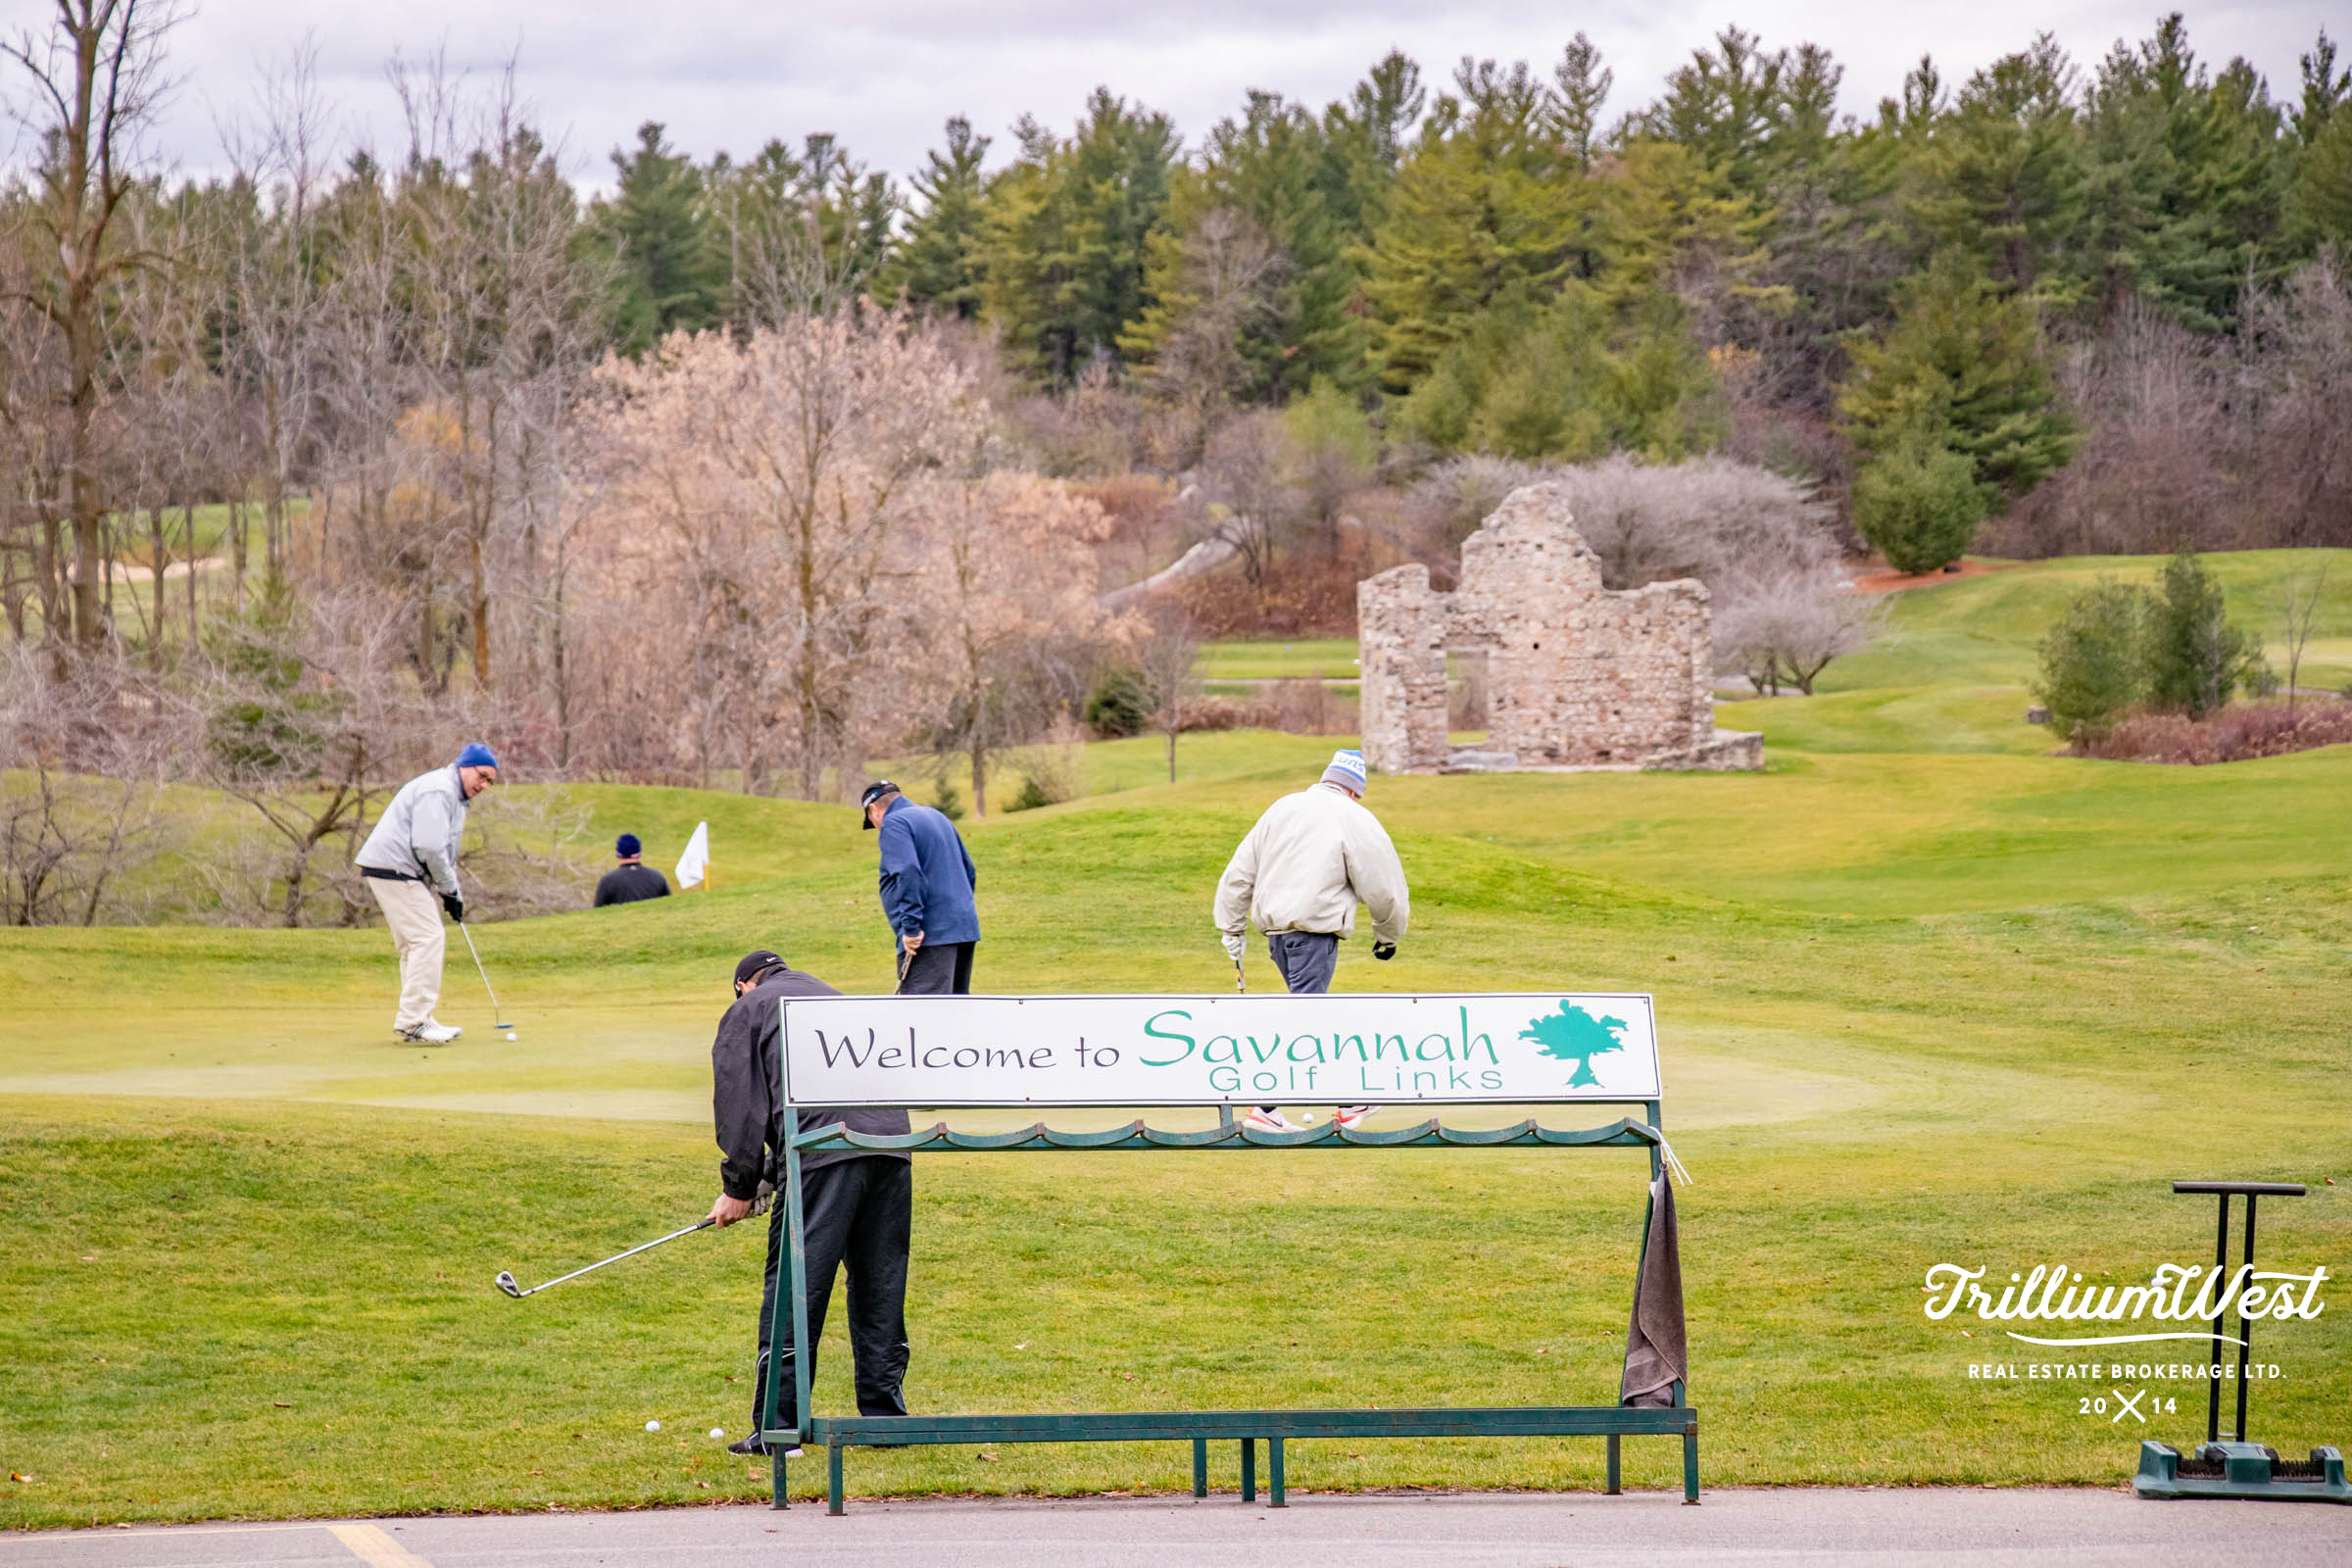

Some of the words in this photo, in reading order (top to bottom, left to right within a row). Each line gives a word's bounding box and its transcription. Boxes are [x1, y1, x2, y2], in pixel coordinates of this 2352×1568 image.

[813, 1026, 1057, 1070] Welcome
[1073, 1036, 1120, 1069] to
[1139, 1005, 1500, 1067] Savannah
[1208, 1065, 1318, 1092] Golf
[1360, 1065, 1504, 1091] Links
